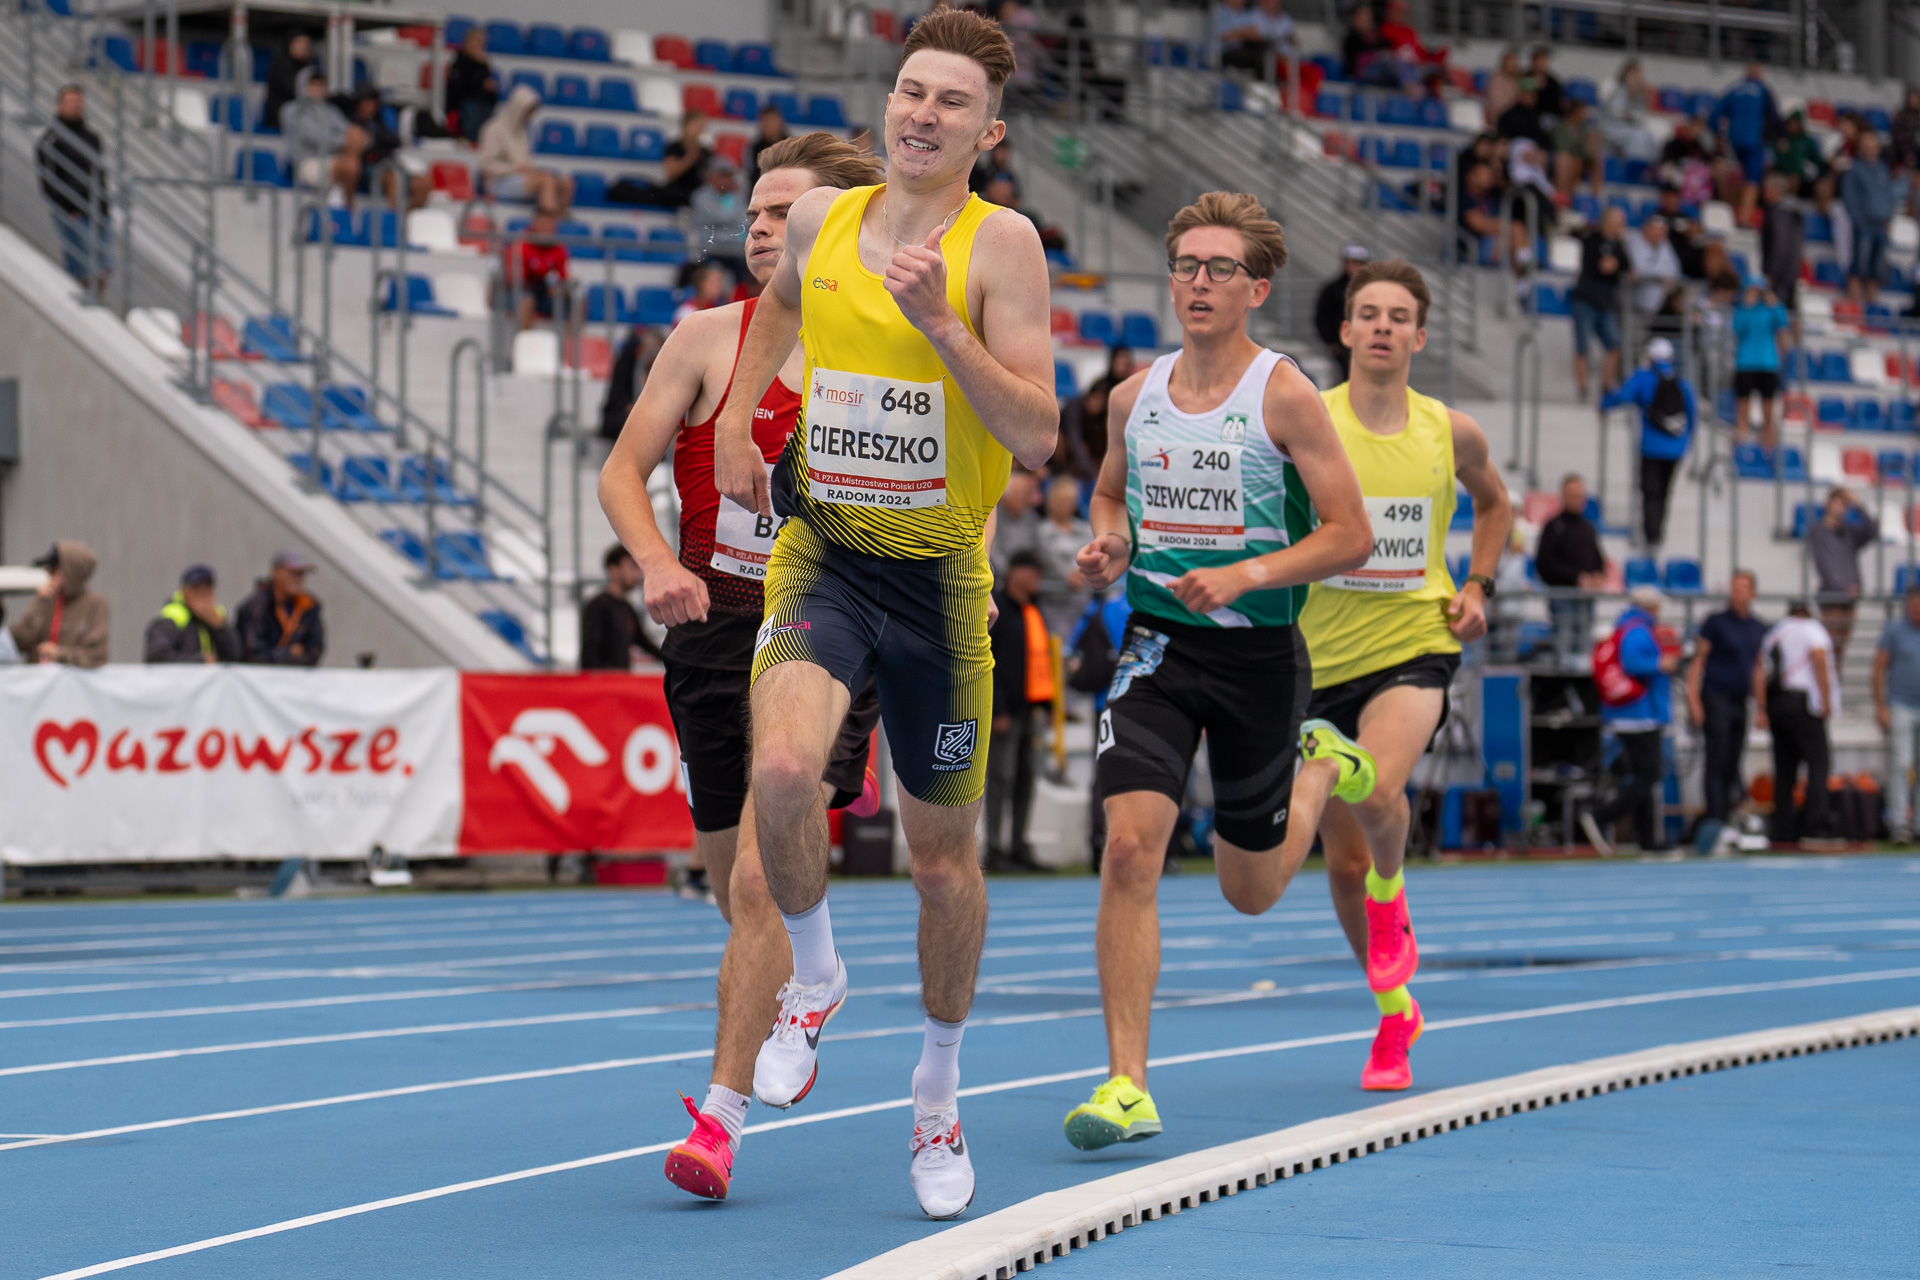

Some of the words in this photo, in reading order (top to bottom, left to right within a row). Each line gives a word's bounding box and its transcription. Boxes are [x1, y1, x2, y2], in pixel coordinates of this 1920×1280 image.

[826, 389, 864, 405] mosir
[881, 388, 931, 415] 648
[811, 424, 939, 464] CIERESZKO
[1193, 450, 1230, 470] 240
[822, 474, 840, 483] PZLA
[842, 477, 889, 489] Mistrzostwa
[891, 482, 915, 491] Polski
[917, 481, 933, 490] U20
[827, 489, 876, 503] RADOM
[879, 494, 911, 505] 2024
[1146, 484, 1239, 512] SZEWCZYK
[1384, 504, 1423, 522] 498
[1159, 535, 1190, 544] RADOM
[1193, 538, 1217, 546] 2024
[736, 551, 752, 560] PZLA
[739, 564, 767, 577] RAD
[932, 762, 971, 771] GRYFINO
